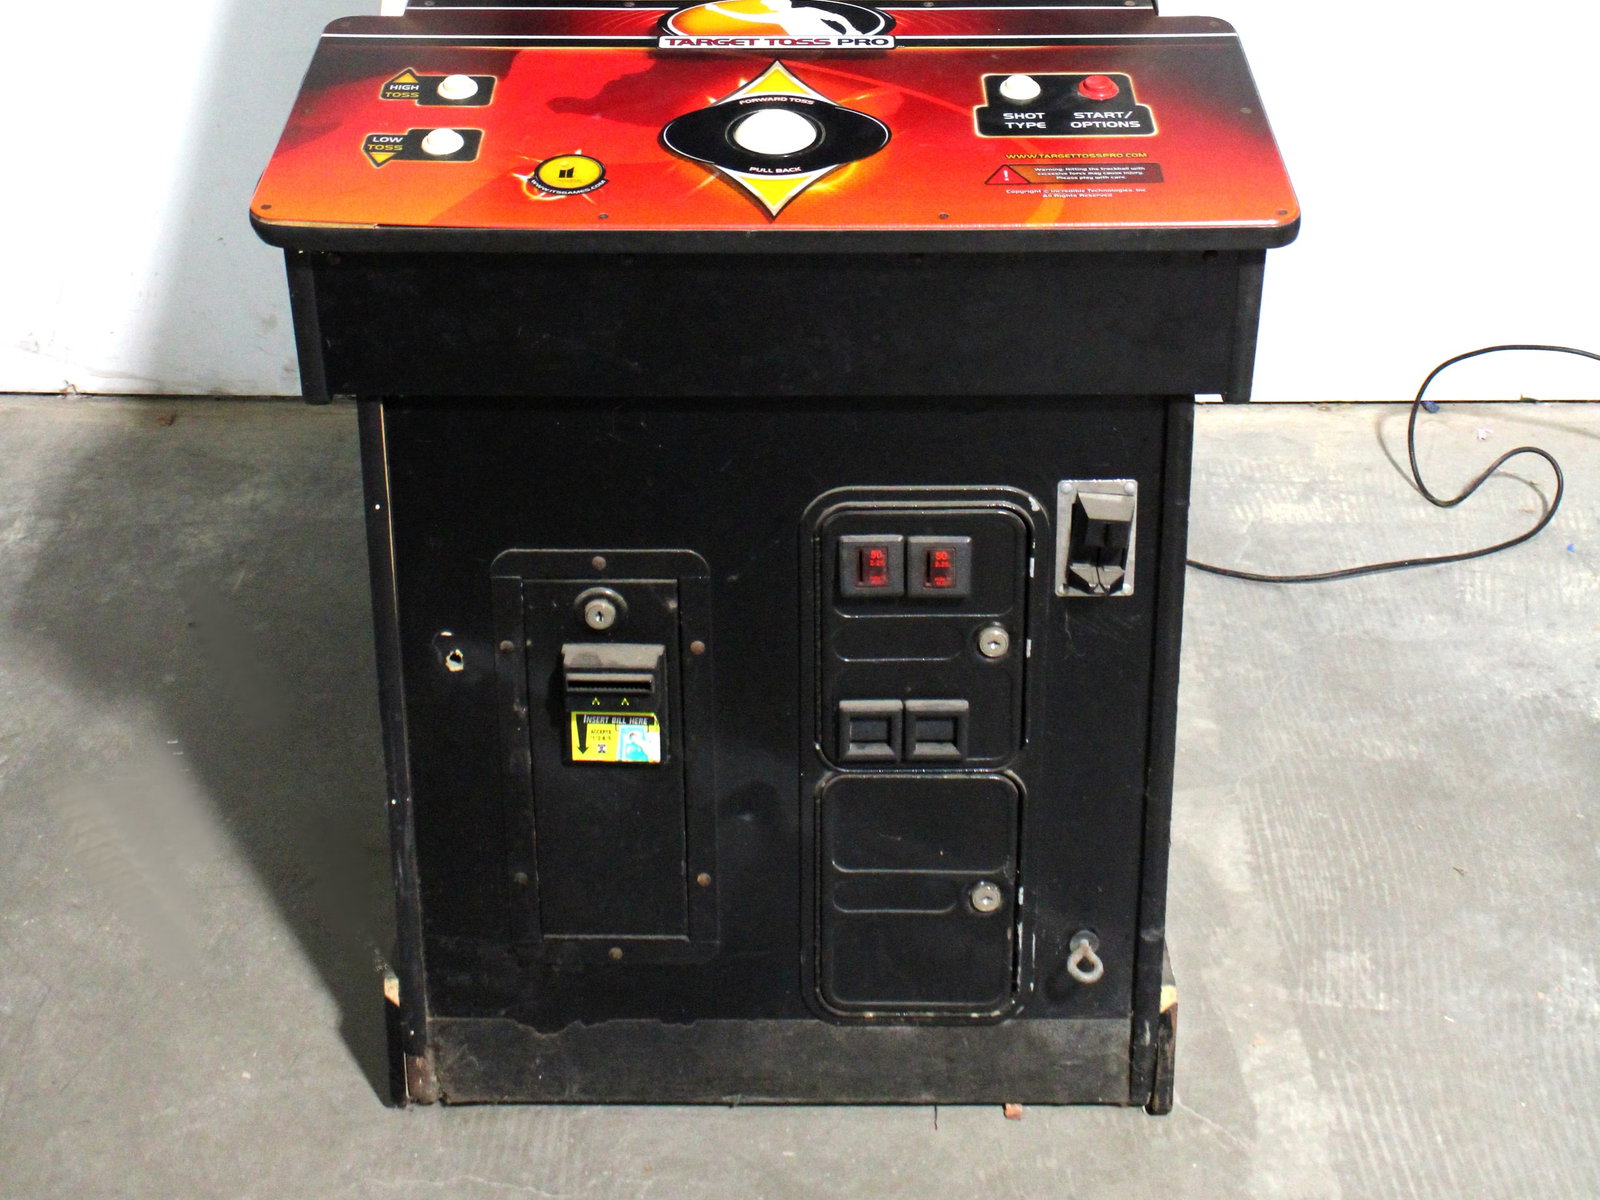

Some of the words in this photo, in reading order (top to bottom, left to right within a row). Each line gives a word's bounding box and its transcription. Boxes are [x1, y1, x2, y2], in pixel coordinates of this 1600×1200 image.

[664, 38, 760, 46] TARGET
[764, 38, 831, 46] TOSS
[837, 38, 890, 46] PRO
[739, 96, 788, 106] FORWARD
[789, 97, 815, 106] TOSS
[1003, 112, 1046, 120] SHOT
[1073, 111, 1134, 120] START/
[1005, 121, 1047, 129] TYPE
[1070, 120, 1141, 129] OPTIONS
[1006, 152, 1149, 160] WWW.TARGETTOSSPRO.COM
[748, 166, 773, 174] PULL
[775, 166, 802, 174] BACK
[583, 714, 609, 724] INSERT
[611, 716, 627, 725] BILL
[629, 717, 648, 725] HERE
